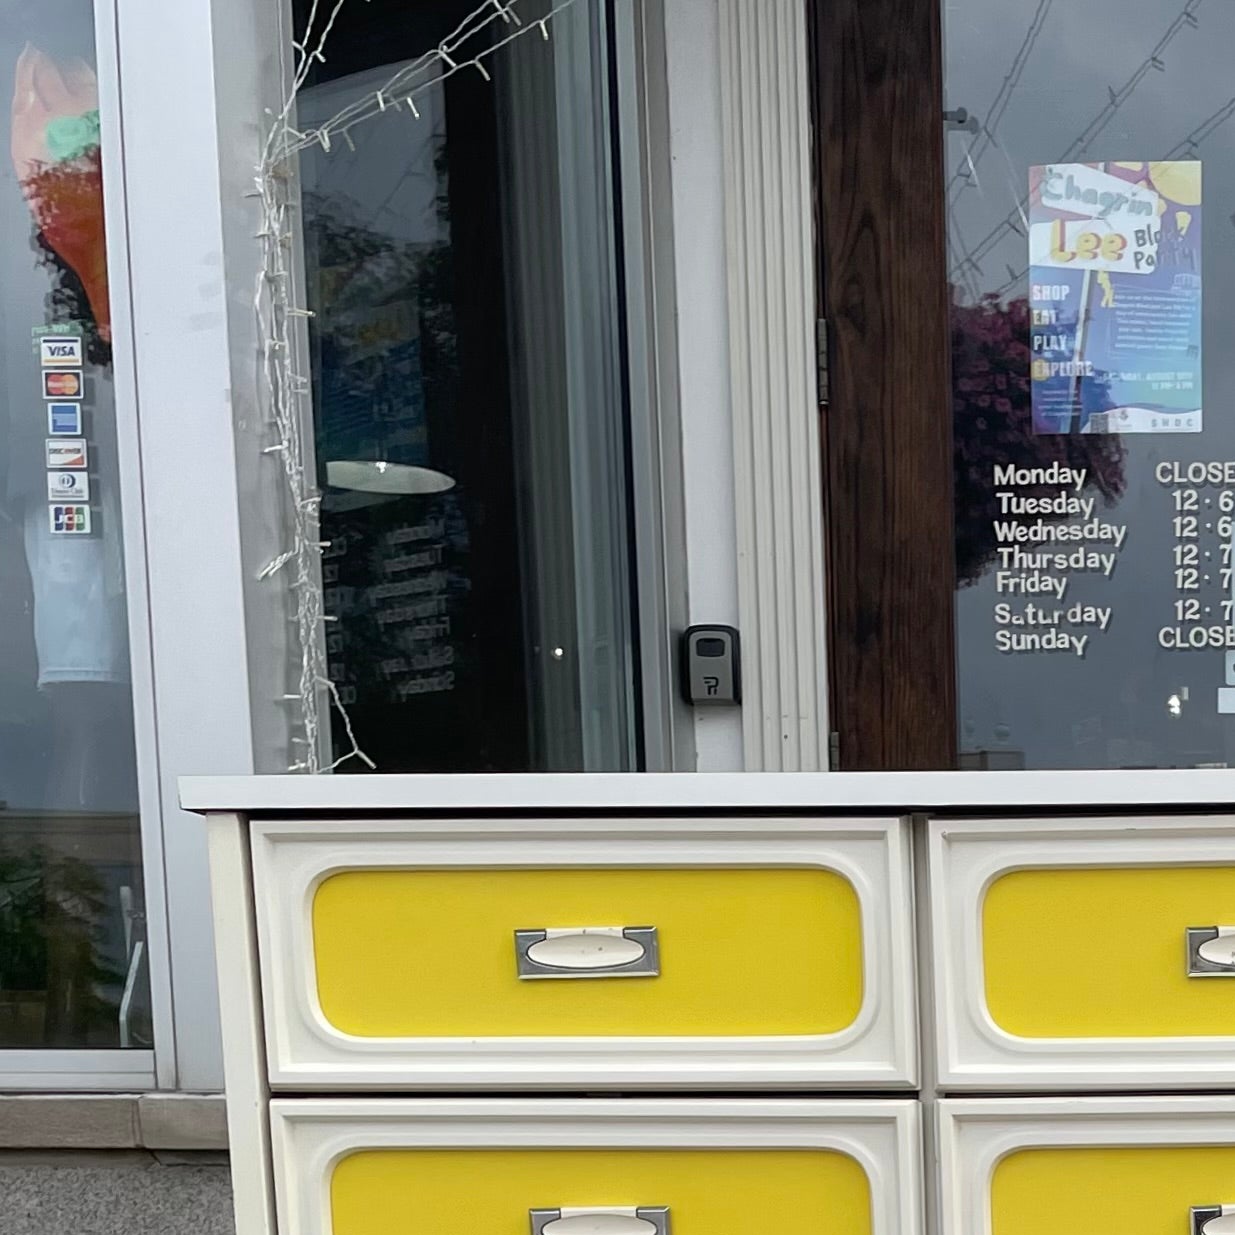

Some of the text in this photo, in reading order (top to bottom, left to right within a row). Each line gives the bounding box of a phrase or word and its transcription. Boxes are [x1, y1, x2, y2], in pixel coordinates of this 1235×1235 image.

[1039, 167, 1153, 216] Chagrin
[1052, 218, 1128, 263] Lee
[1031, 284, 1070, 300] SHOP
[1032, 309, 1057, 325] EAT
[48, 345, 76, 357] VISA
[1033, 335, 1068, 351] PLAY
[993, 461, 1087, 492] Monday
[54, 513, 85, 524] JCB
[995, 490, 1095, 520] Tuesday
[993, 517, 1127, 548] Wednesday
[997, 544, 1116, 576] Thursday
[996, 570, 1067, 600] Friday
[995, 627, 1088, 656] Sunday
